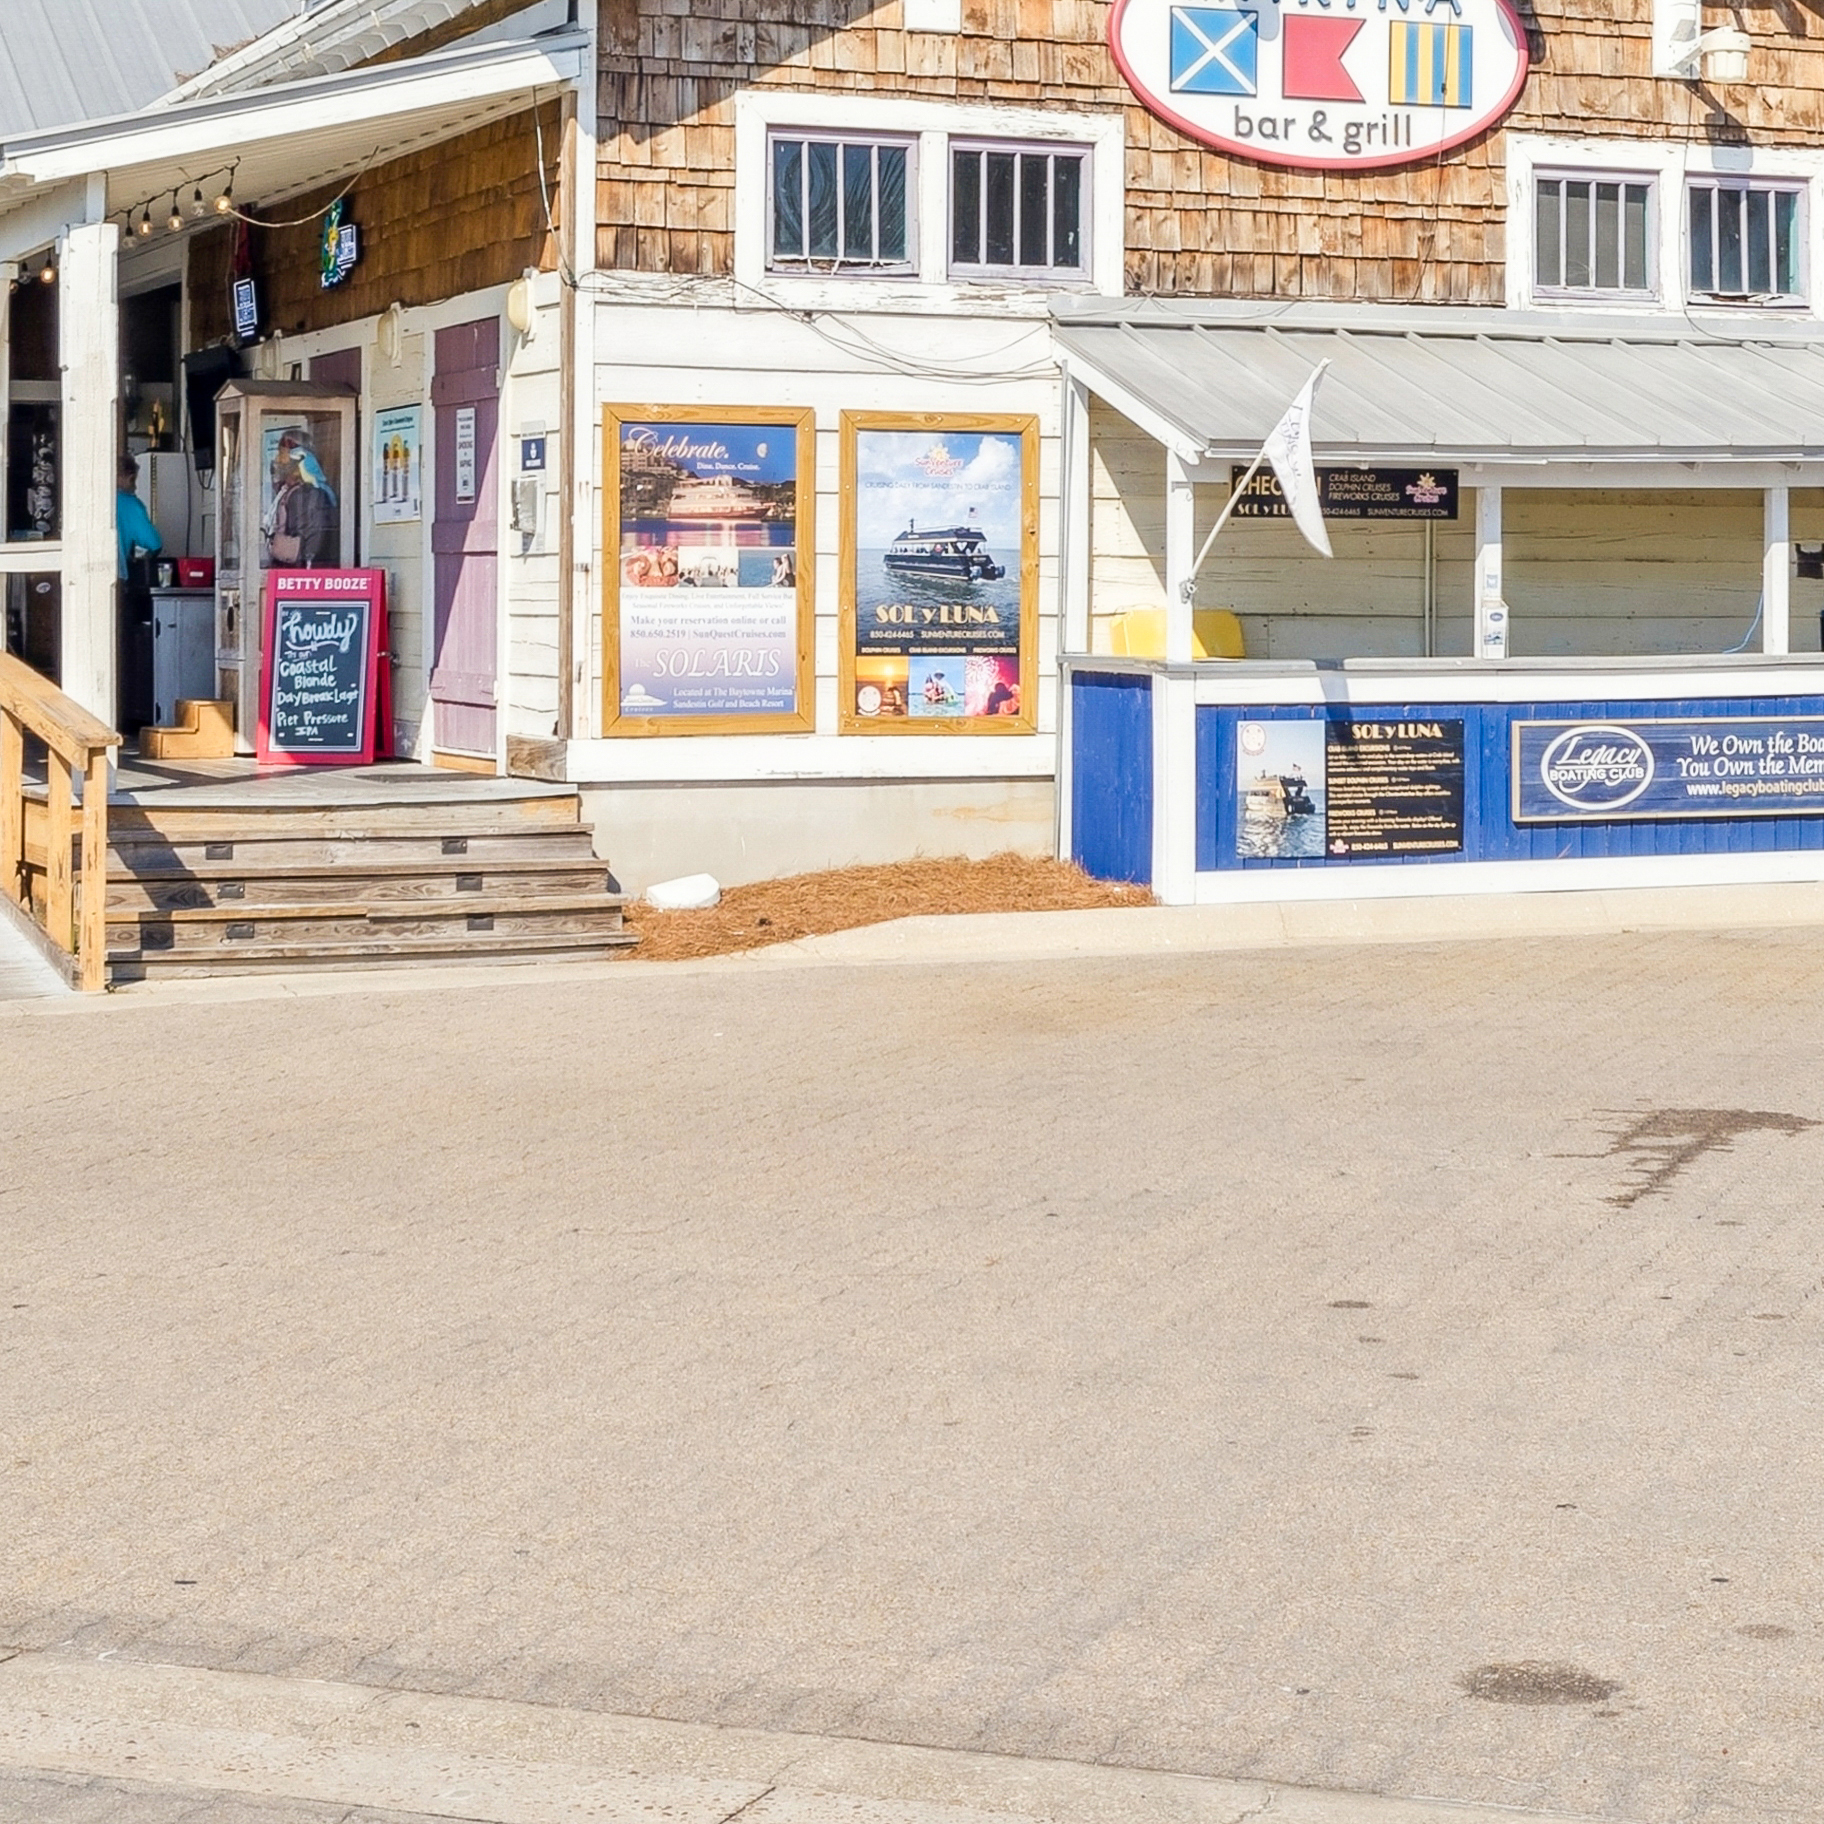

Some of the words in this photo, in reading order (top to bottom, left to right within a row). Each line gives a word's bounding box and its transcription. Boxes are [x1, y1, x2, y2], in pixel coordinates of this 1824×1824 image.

[1234, 106, 1296, 141] bar
[1308, 110, 1333, 143] &
[1343, 114, 1412, 154] grill
[628, 427, 730, 459] Celebrate.
[1235, 475, 1283, 496] CHEC
[1329, 474, 1349, 482] CRAB
[1350, 474, 1376, 482] ISLAND
[1328, 483, 1361, 492] DOLPHIN
[1362, 483, 1392, 492] CRUISES
[1328, 492, 1370, 501] FIREWORKS
[1371, 492, 1400, 501] CRUISES
[1238, 503, 1261, 514] SOL
[1262, 506, 1271, 515] y
[1273, 504, 1290, 515] LU
[277, 577, 322, 591] BETTY
[324, 577, 368, 591] BOOZE
[630, 616, 655, 625] Make
[657, 617, 677, 627] your
[680, 616, 727, 625] reservation
[730, 616, 757, 625] online
[770, 616, 787, 625] call
[876, 604, 918, 624] SOL
[921, 608, 937, 624] y
[940, 604, 1000, 624] LUNA
[282, 612, 358, 652] howdy
[630, 629, 686, 639] 850.650.2519
[693, 629, 787, 640] SunQuestCruises.com
[280, 655, 338, 677] Coastal
[635, 659, 651, 668] The
[653, 648, 782, 677] SOLARIS
[294, 674, 337, 690] Blonde
[277, 690, 302, 706] Day
[673, 687, 703, 696] Located
[704, 688, 713, 696] at
[714, 687, 727, 696] The
[729, 687, 766, 698] Baytowne
[767, 686, 793, 696] Marina
[672, 699, 706, 708] Sandestin
[707, 699, 724, 708] Golf
[725, 699, 737, 708] and
[739, 699, 760, 708] Beach
[762, 699, 784, 708] Resort
[277, 712, 299, 727] Pier
[304, 711, 349, 726] Pressure
[295, 727, 319, 736] IPA
[1352, 724, 1383, 739] SOL
[1384, 726, 1396, 739] y
[1398, 723, 1443, 738] LUNA
[1690, 734, 1720, 756] We
[1722, 735, 1763, 755] Own
[1767, 731, 1794, 754] the
[1556, 736, 1642, 793] Legacy
[1677, 757, 1711, 778] You
[1713, 756, 1755, 776] Own
[1758, 754, 1785, 775] the
[1549, 768, 1607, 782] BOATING
[1609, 766, 1644, 780] CLUB
